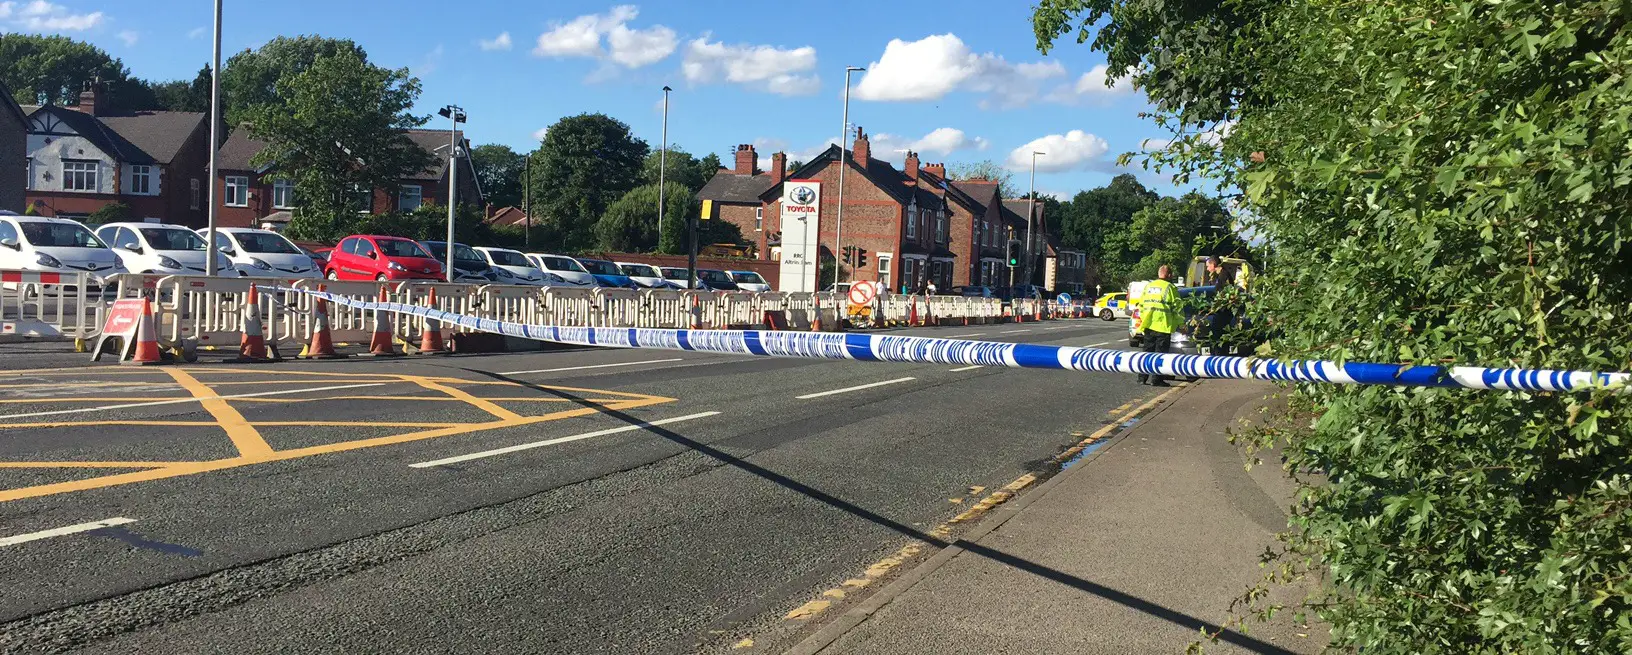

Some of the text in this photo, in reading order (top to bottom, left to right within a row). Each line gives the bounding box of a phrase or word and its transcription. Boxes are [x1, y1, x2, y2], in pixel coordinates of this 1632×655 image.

[786, 205, 816, 213] TOYOTA
[878, 336, 1013, 367] POLICE LINE DO NOT CROSS
[1071, 349, 1122, 372] POLICE
